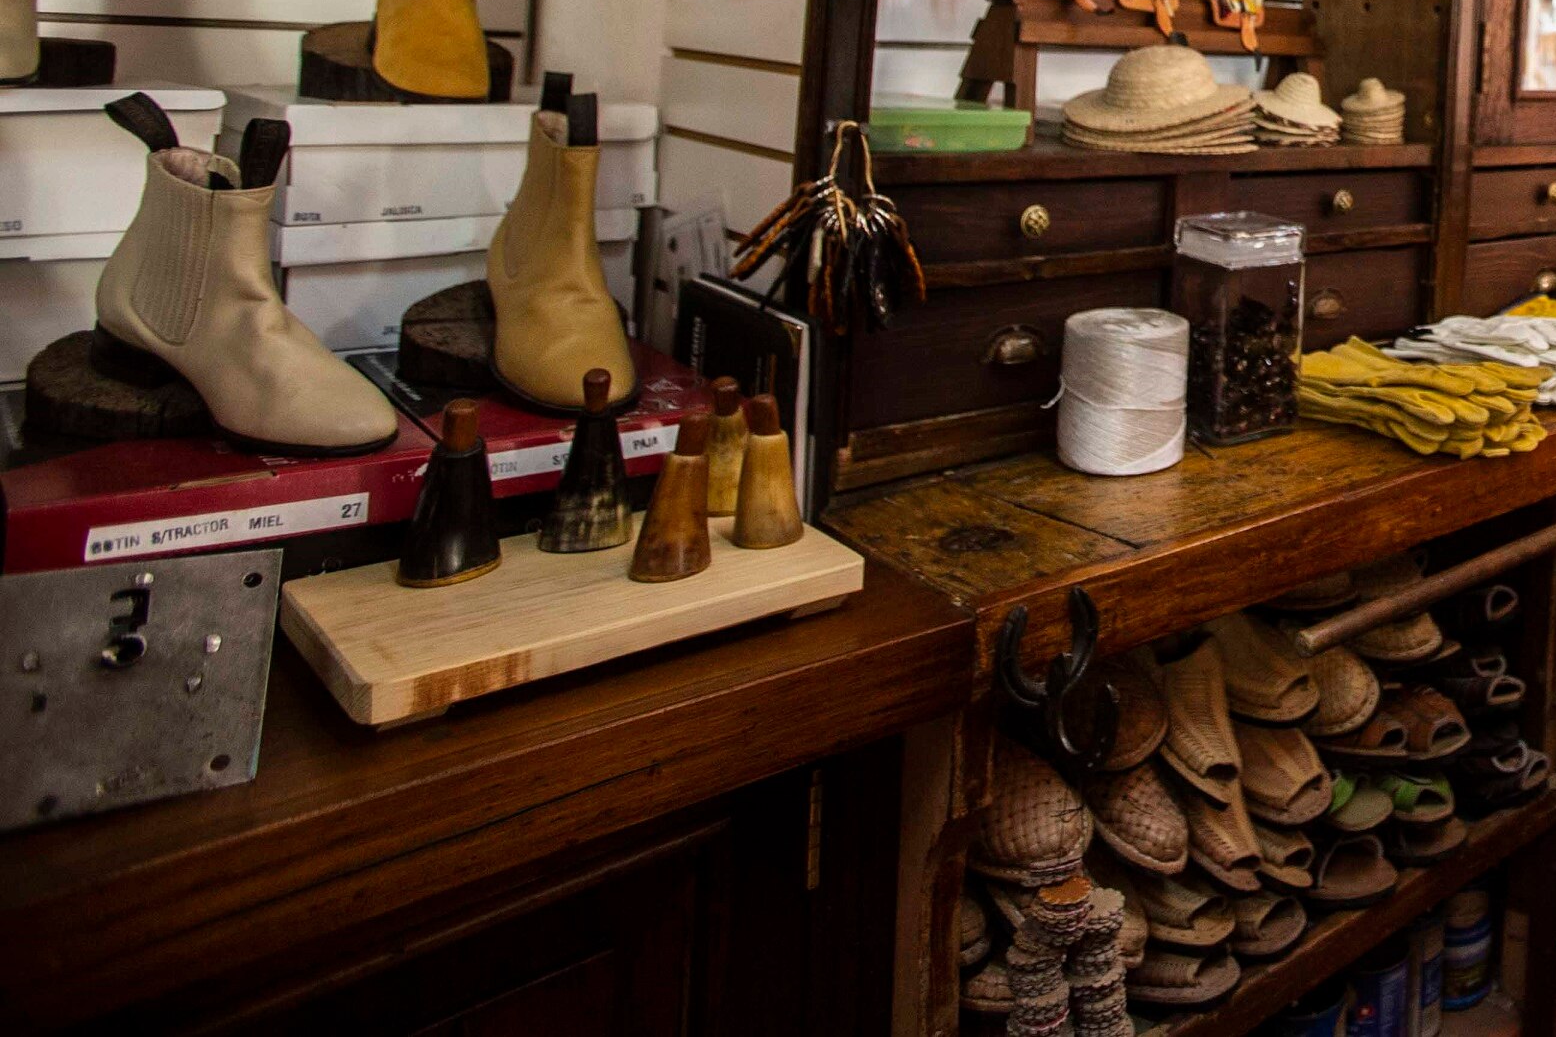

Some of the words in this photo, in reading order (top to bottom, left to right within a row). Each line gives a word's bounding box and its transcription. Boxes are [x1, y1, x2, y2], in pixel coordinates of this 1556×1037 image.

[151, 518, 229, 545] S/TRACTOR
[248, 514, 283, 531] MIEL
[341, 502, 362, 519] 27
